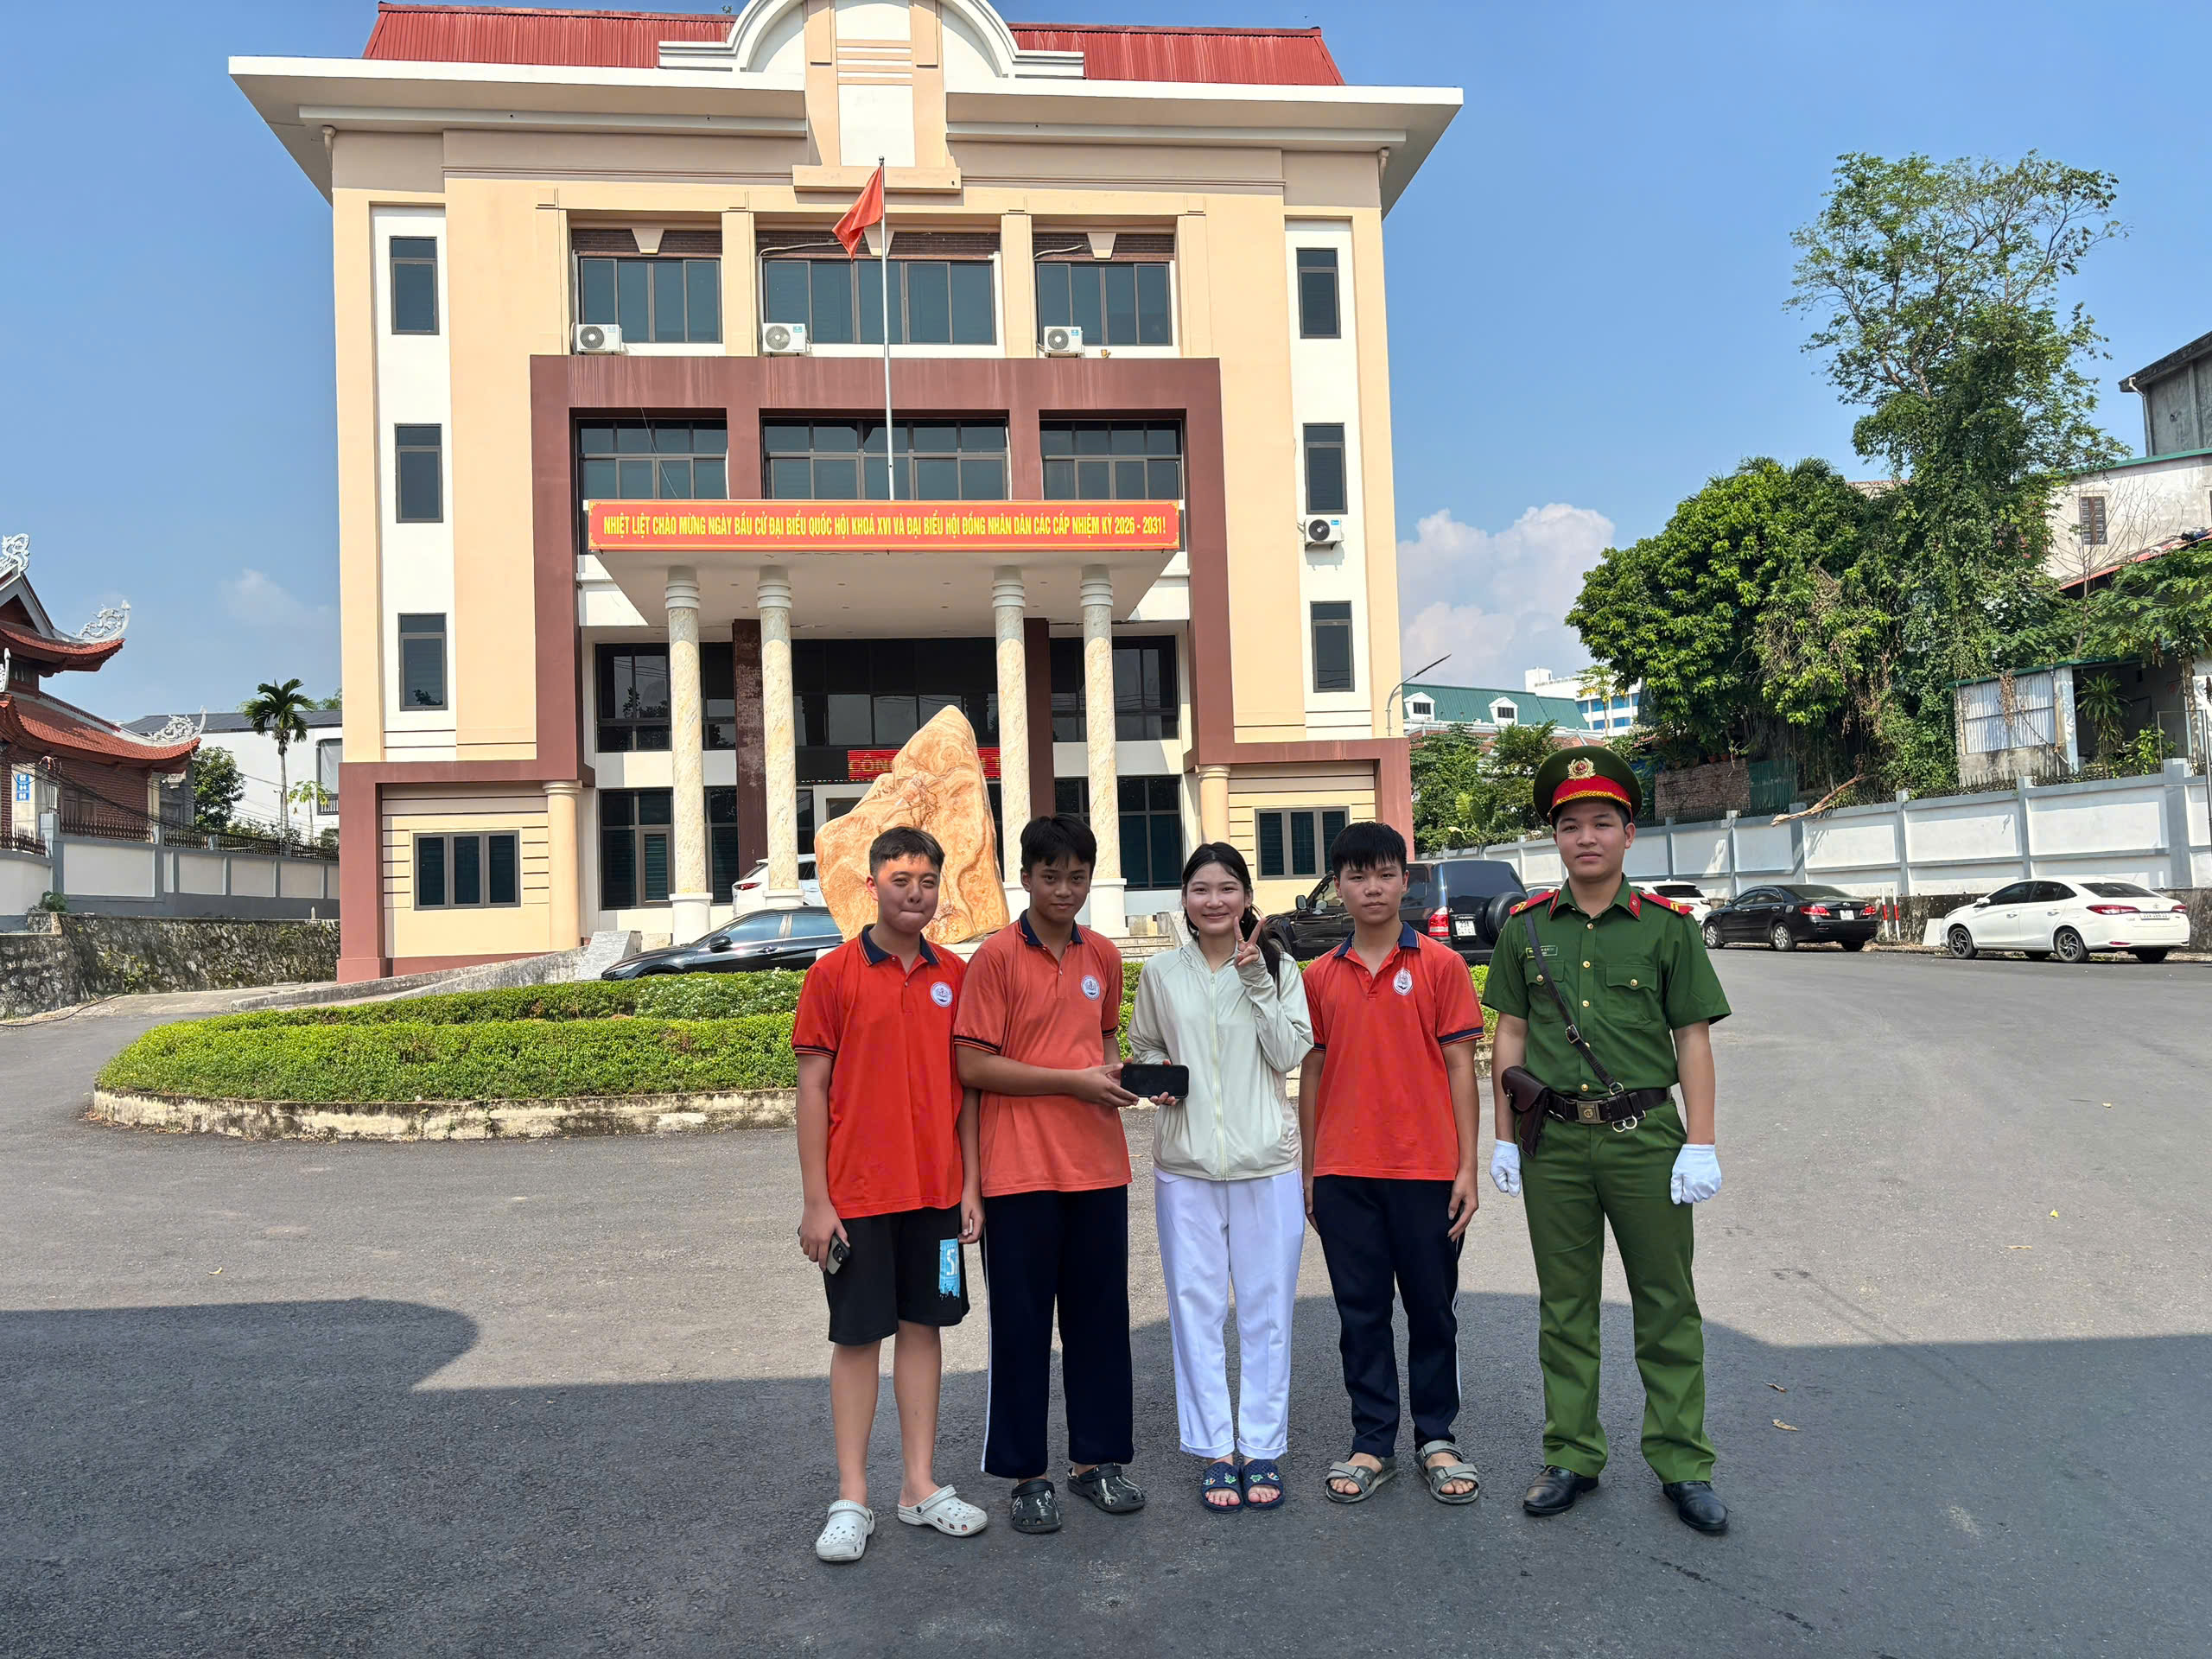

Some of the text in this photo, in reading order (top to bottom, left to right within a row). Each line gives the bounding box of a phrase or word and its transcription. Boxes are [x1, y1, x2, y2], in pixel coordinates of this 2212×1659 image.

[604, 512, 630, 538] NHIỆT
[632, 512, 650, 538] LIỆT
[653, 512, 677, 535] CHÀO
[679, 512, 706, 535] MỪNG
[709, 512, 732, 535] NGÀY
[755, 511, 767, 535] CỬ
[769, 517, 784, 539] ĐẠI
[786, 510, 806, 535] BIỂU
[809, 511, 832, 537] QUỐC
[835, 513, 849, 539] HỘI
[878, 517, 892, 535] XVI
[893, 513, 906, 535] VÀ
[907, 517, 922, 539] ĐẠI
[924, 510, 944, 535] BIỂU
[945, 513, 960, 539] HỘI
[988, 513, 1012, 535] NHÂN
[1014, 513, 1032, 535] DÂN
[1034, 512, 1051, 535] CÁC
[1053, 511, 1070, 535] CẤP
[1072, 512, 1099, 539] NHIỆM
[1102, 512, 1113, 534] KỲ
[1115, 517, 1135, 534] 2026
[1142, 517, 1166, 534] 2031!
